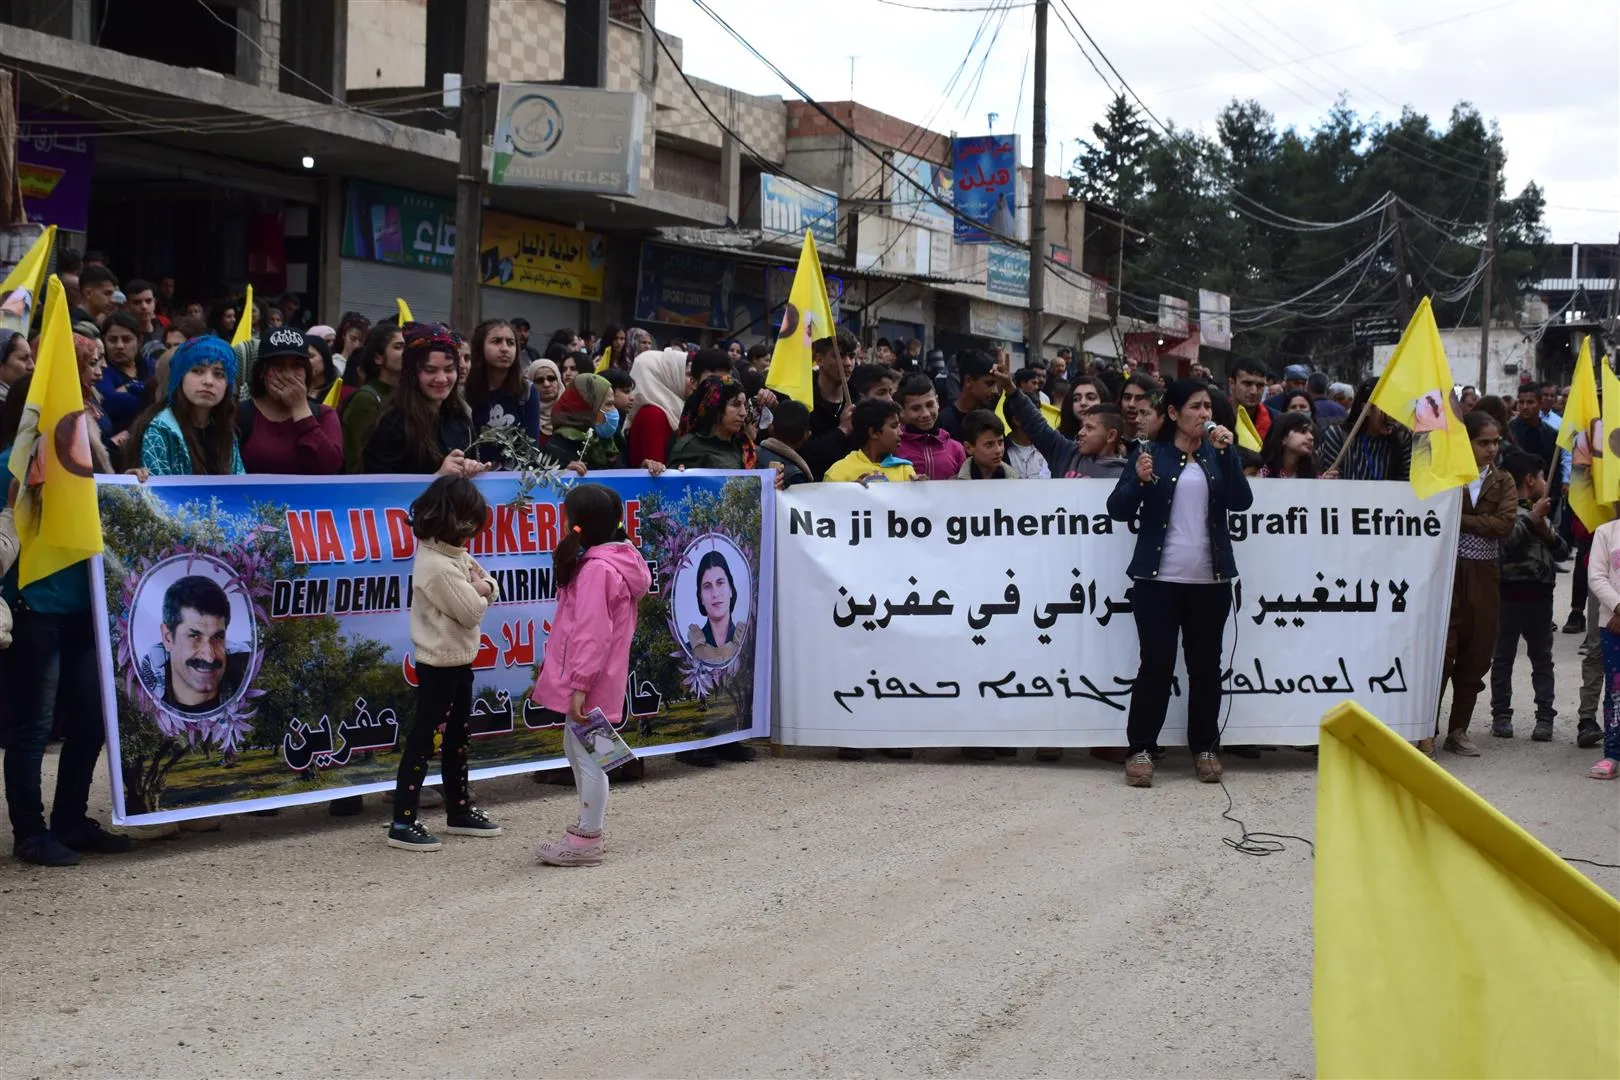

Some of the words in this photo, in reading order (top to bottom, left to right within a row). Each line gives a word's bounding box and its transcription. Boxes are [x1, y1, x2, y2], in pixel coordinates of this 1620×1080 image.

[286, 509, 345, 564] NA
[348, 508, 382, 562] JI
[789, 507, 837, 538] Na
[848, 510, 872, 546] ji
[887, 510, 932, 538] bo
[946, 507, 1114, 545] guherîna
[1321, 507, 1339, 535] li
[1352, 508, 1442, 538] Efrînê
[272, 577, 331, 618] DEM
[333, 575, 400, 614] DEMA
[833, 575, 954, 632] عفرين
[967, 568, 1020, 646] في
[1251, 571, 1380, 629] للتغيير
[1388, 578, 1410, 613] لا
[283, 697, 399, 771] عفرين
